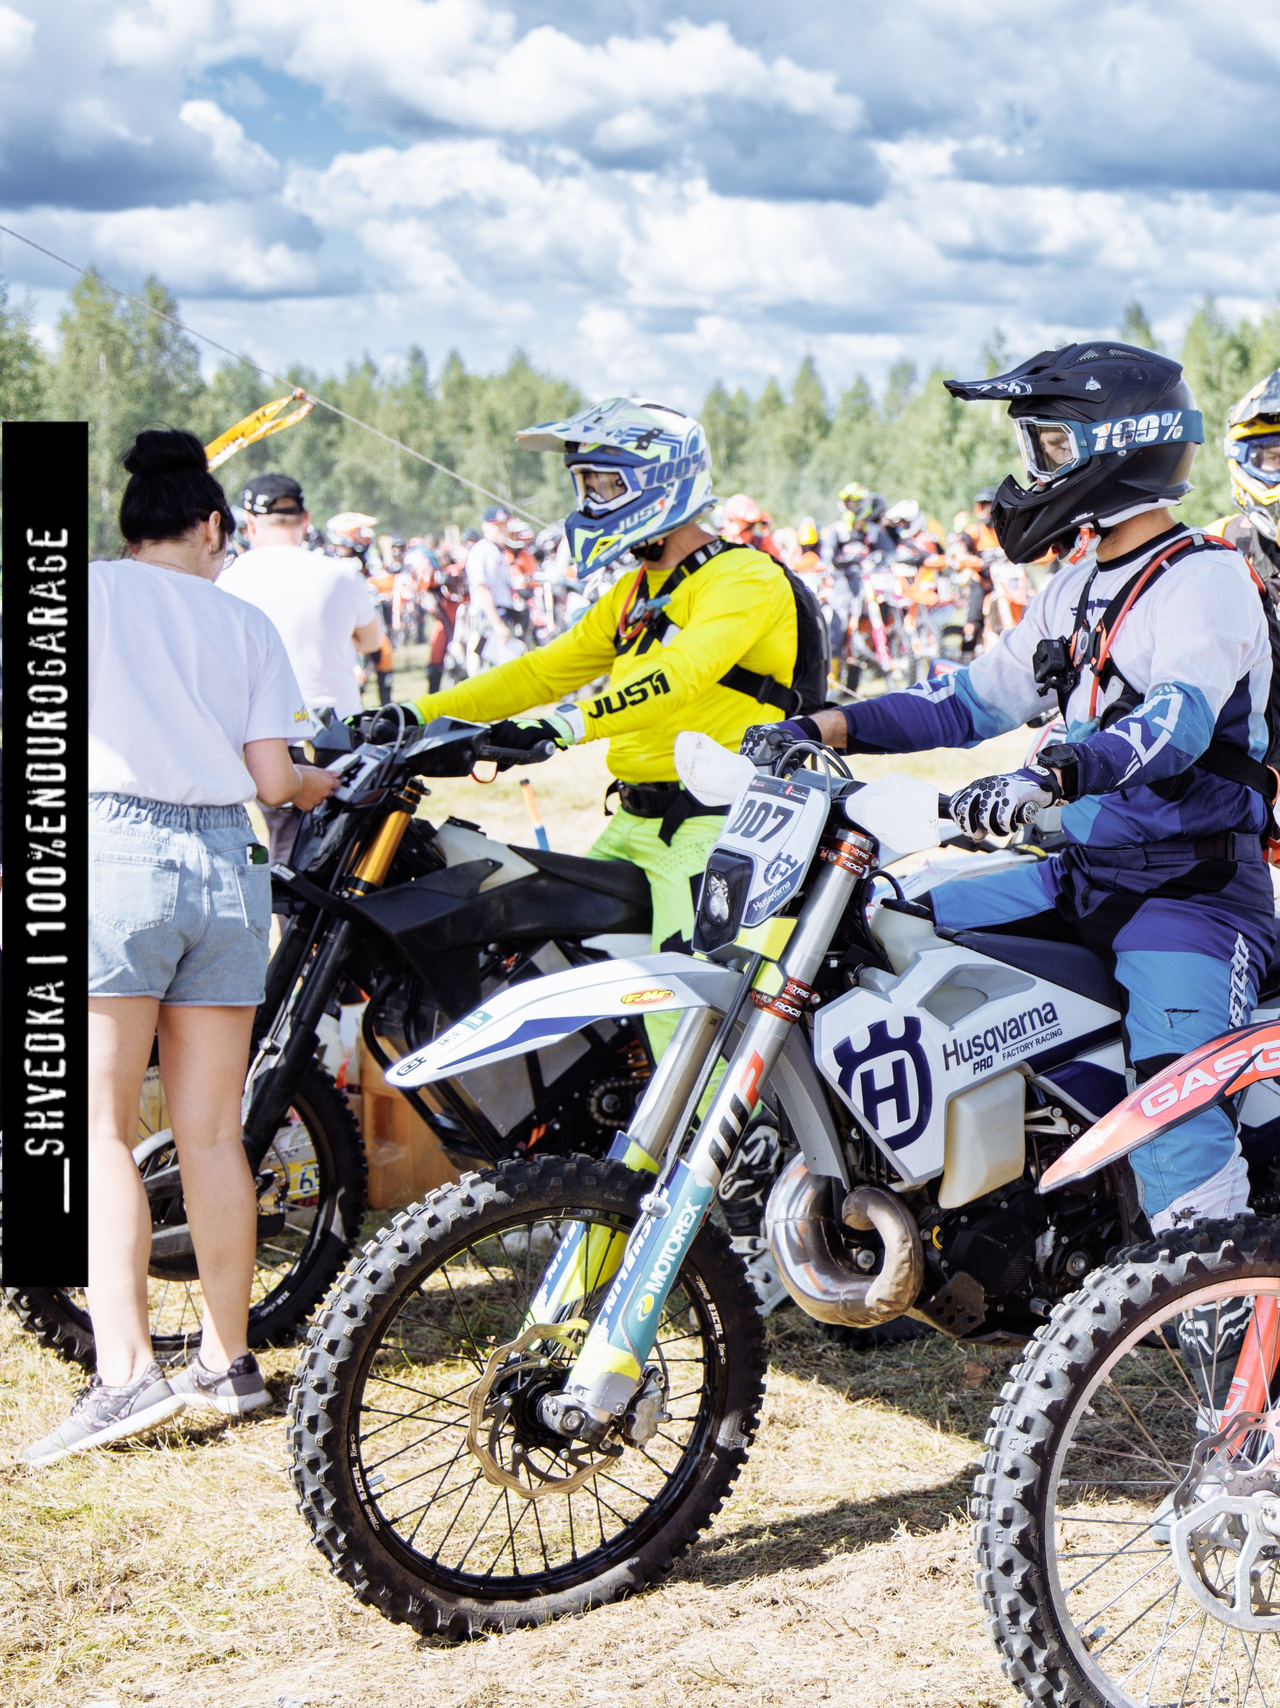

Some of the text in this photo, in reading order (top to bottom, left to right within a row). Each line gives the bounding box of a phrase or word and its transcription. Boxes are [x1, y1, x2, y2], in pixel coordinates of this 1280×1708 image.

[1091, 412, 1183, 452] 100%
[641, 452, 708, 488] 100%
[612, 497, 666, 535] JUST1
[588, 669, 671, 719] JUST1
[727, 799, 795, 844] 007
[752, 881, 792, 911] Husqvarna
[774, 1001, 802, 1018] ROCS
[942, 1001, 1059, 1071] Husqvarna
[1002, 1028, 1063, 1061] FACTORY RACING
[973, 1055, 993, 1075] PRO
[652, 1200, 701, 1294] MOTOREX
[707, 1302, 724, 1339] EXCEL
[352, 1462, 368, 1502] EXCEL
